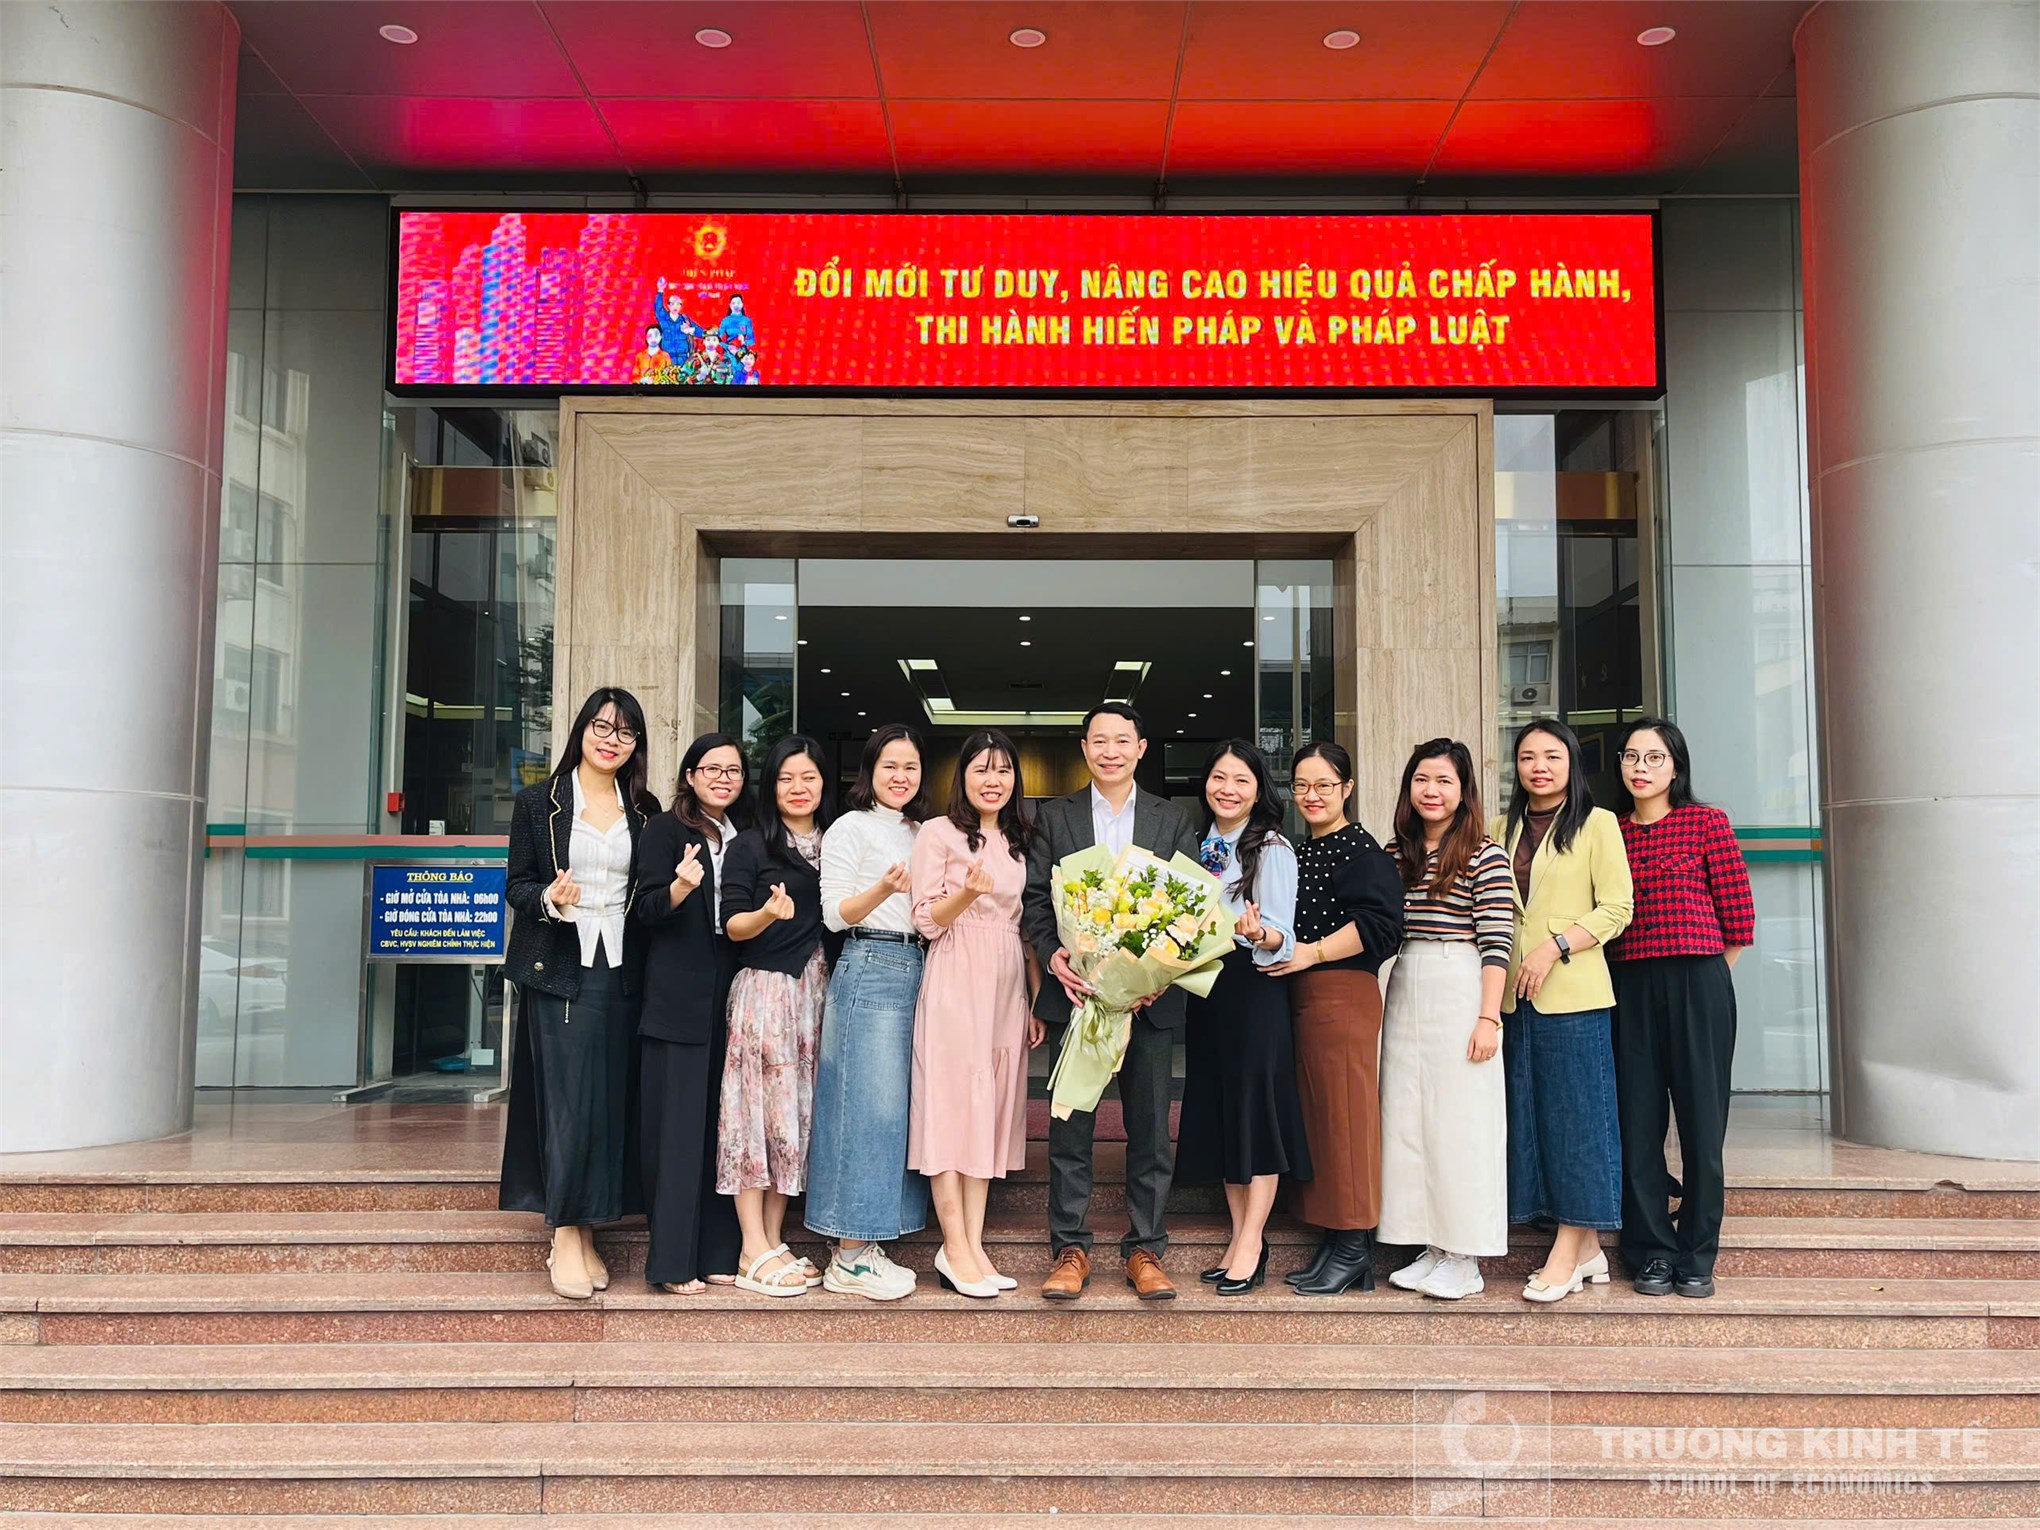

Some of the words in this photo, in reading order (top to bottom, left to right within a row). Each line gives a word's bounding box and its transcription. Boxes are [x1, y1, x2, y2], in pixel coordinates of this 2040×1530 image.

[794, 256, 852, 298] ĐỔI
[865, 261, 929, 298] MỚI
[940, 265, 984, 298] TƯ
[995, 269, 1069, 303] DUY,
[1081, 263, 1169, 299] NÂNG
[1182, 269, 1247, 299] CAO
[1260, 263, 1337, 304] HIỆU
[1350, 260, 1417, 301] QUẢ
[1429, 259, 1517, 298] CHẤP
[1530, 262, 1631, 303] HÀNH,
[915, 315, 968, 344] THI
[981, 308, 1070, 344] HÀNH
[1083, 305, 1160, 345] HIẾN
[1173, 309, 1261, 345] PHÁP
[1273, 309, 1316, 345] VÀ
[1328, 308, 1417, 345] PHÁP
[1430, 308, 1510, 351] LUẬT
[406, 870, 447, 881] THÔNG
[449, 870, 474, 881] BÁO
[401, 888, 415, 905] MỞ
[415, 888, 432, 905] CỬA
[433, 890, 449, 905] TÒA
[450, 890, 470, 905] NHÀ:
[399, 909, 420, 923] ĐÓNG
[421, 906, 437, 923] CỬA
[438, 909, 453, 923] TÒA
[454, 909, 473, 923] NHÀ:
[474, 911, 498, 923] 22h00
[390, 928, 403, 937] YÊU
[420, 928, 442, 937] KHÁCH
[471, 928, 486, 939] VIỆC
